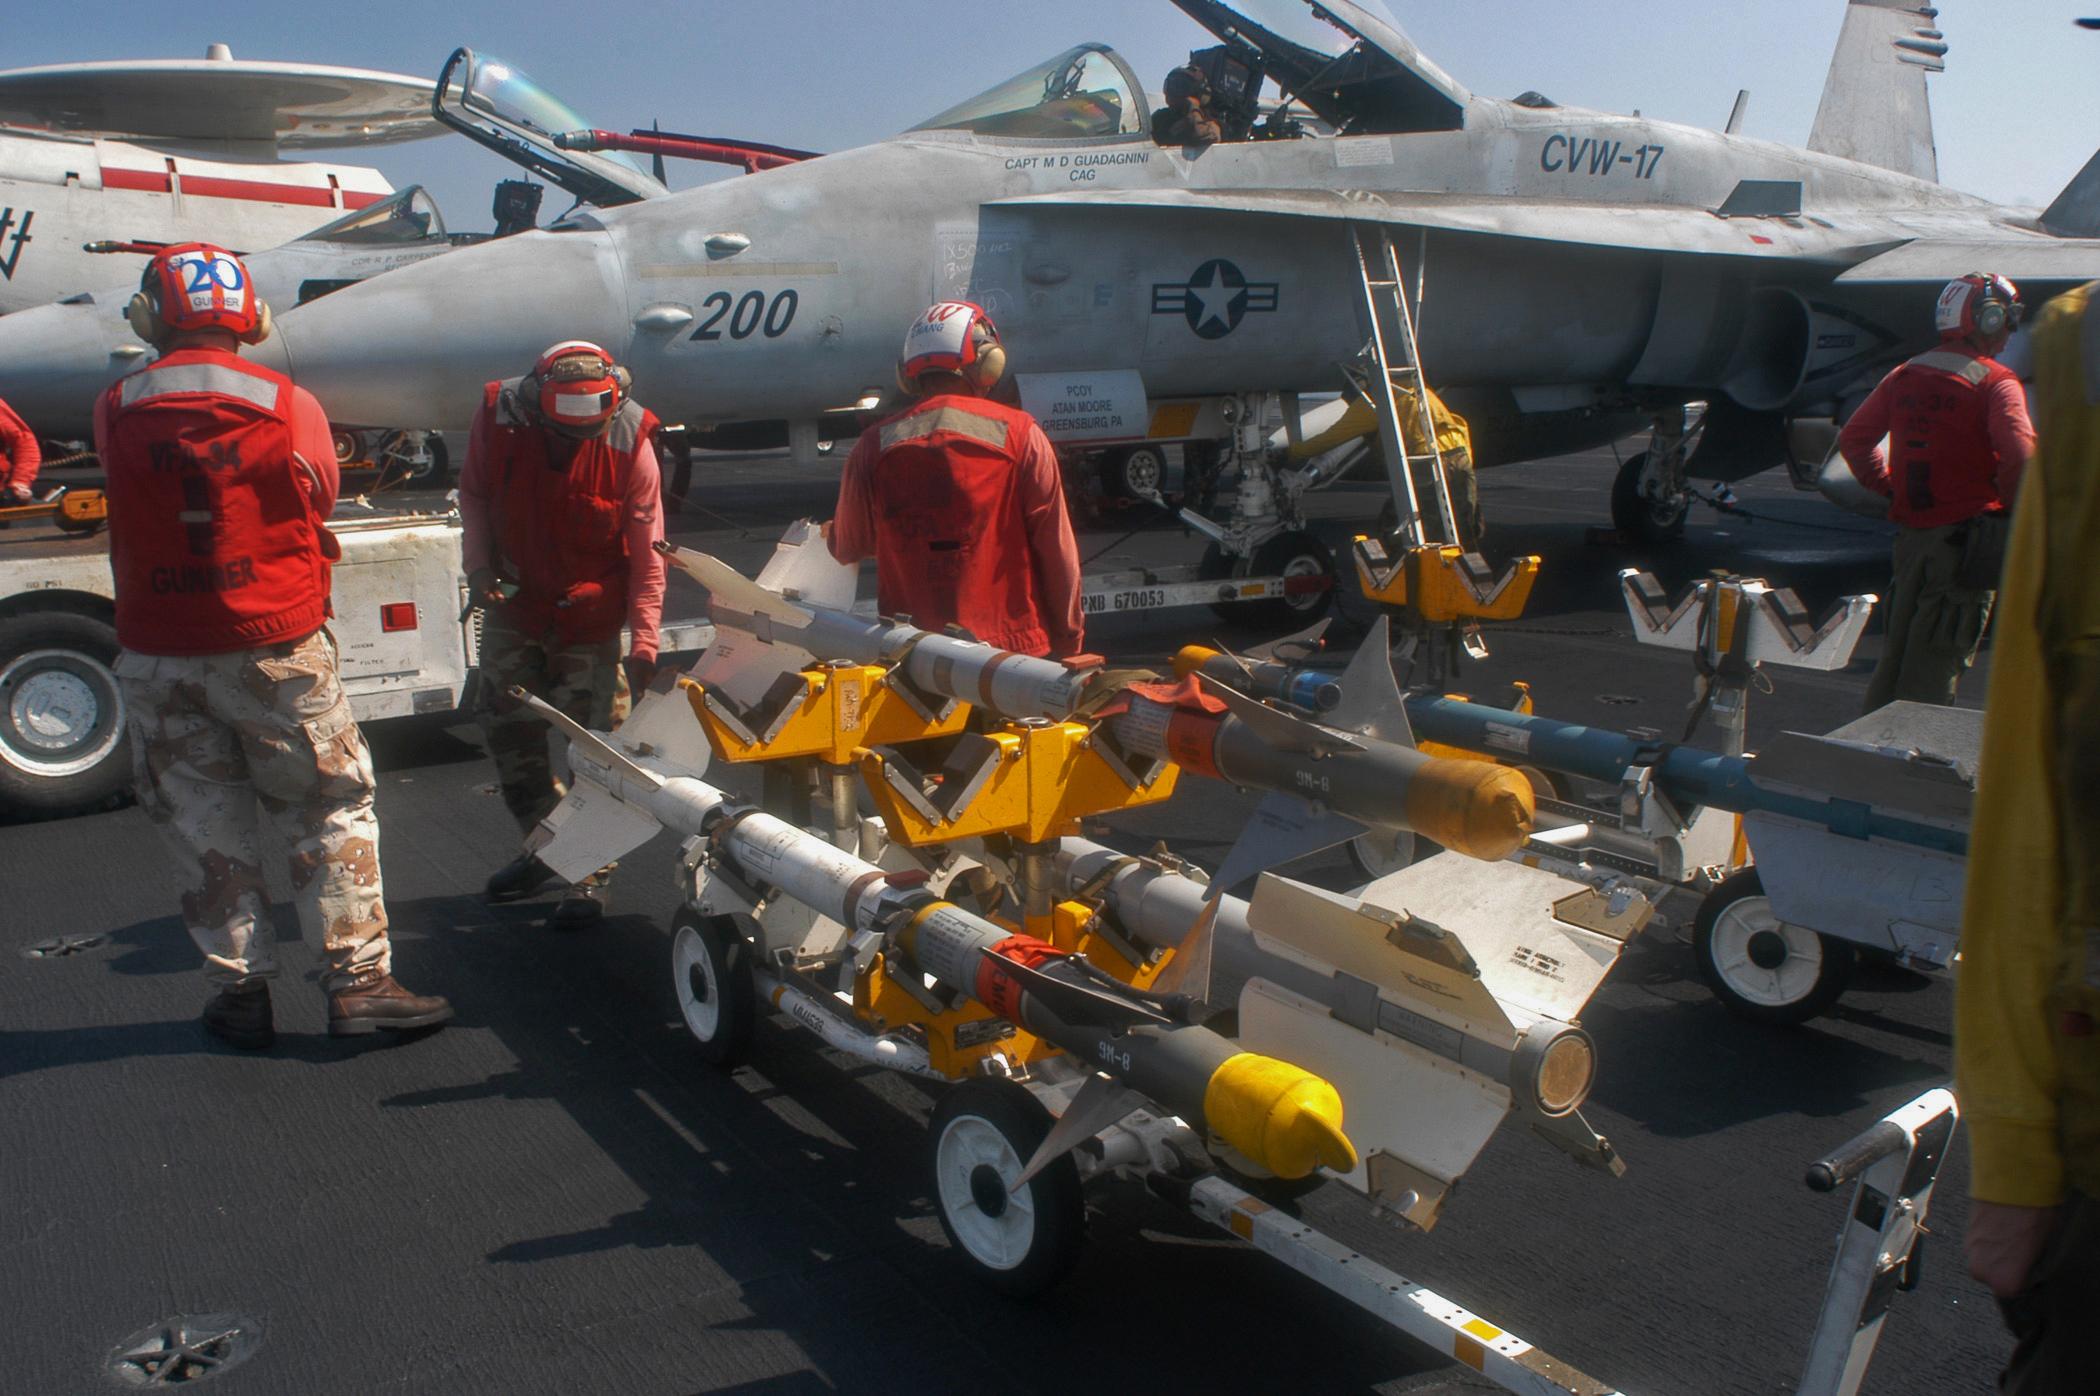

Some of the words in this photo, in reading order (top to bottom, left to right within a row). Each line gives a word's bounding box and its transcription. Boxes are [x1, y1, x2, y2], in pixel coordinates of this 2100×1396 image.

[1005, 157, 1038, 169] CAPT
[1043, 156, 1055, 168] M
[1060, 156, 1069, 167] D
[1074, 152, 1150, 166] GUADAGNINI
[1541, 134, 1664, 179] CVW-17
[1069, 169, 1096, 181] CAG
[187, 258, 244, 293] 20
[689, 289, 799, 341] 200
[1066, 385, 1093, 397] PCOY
[1052, 402, 1076, 415] ATAN
[1078, 400, 1113, 413] MOORE
[1042, 418, 1109, 432] GREENSBURG
[1110, 415, 1123, 427] PA
[1114, 590, 1165, 610] 670053
